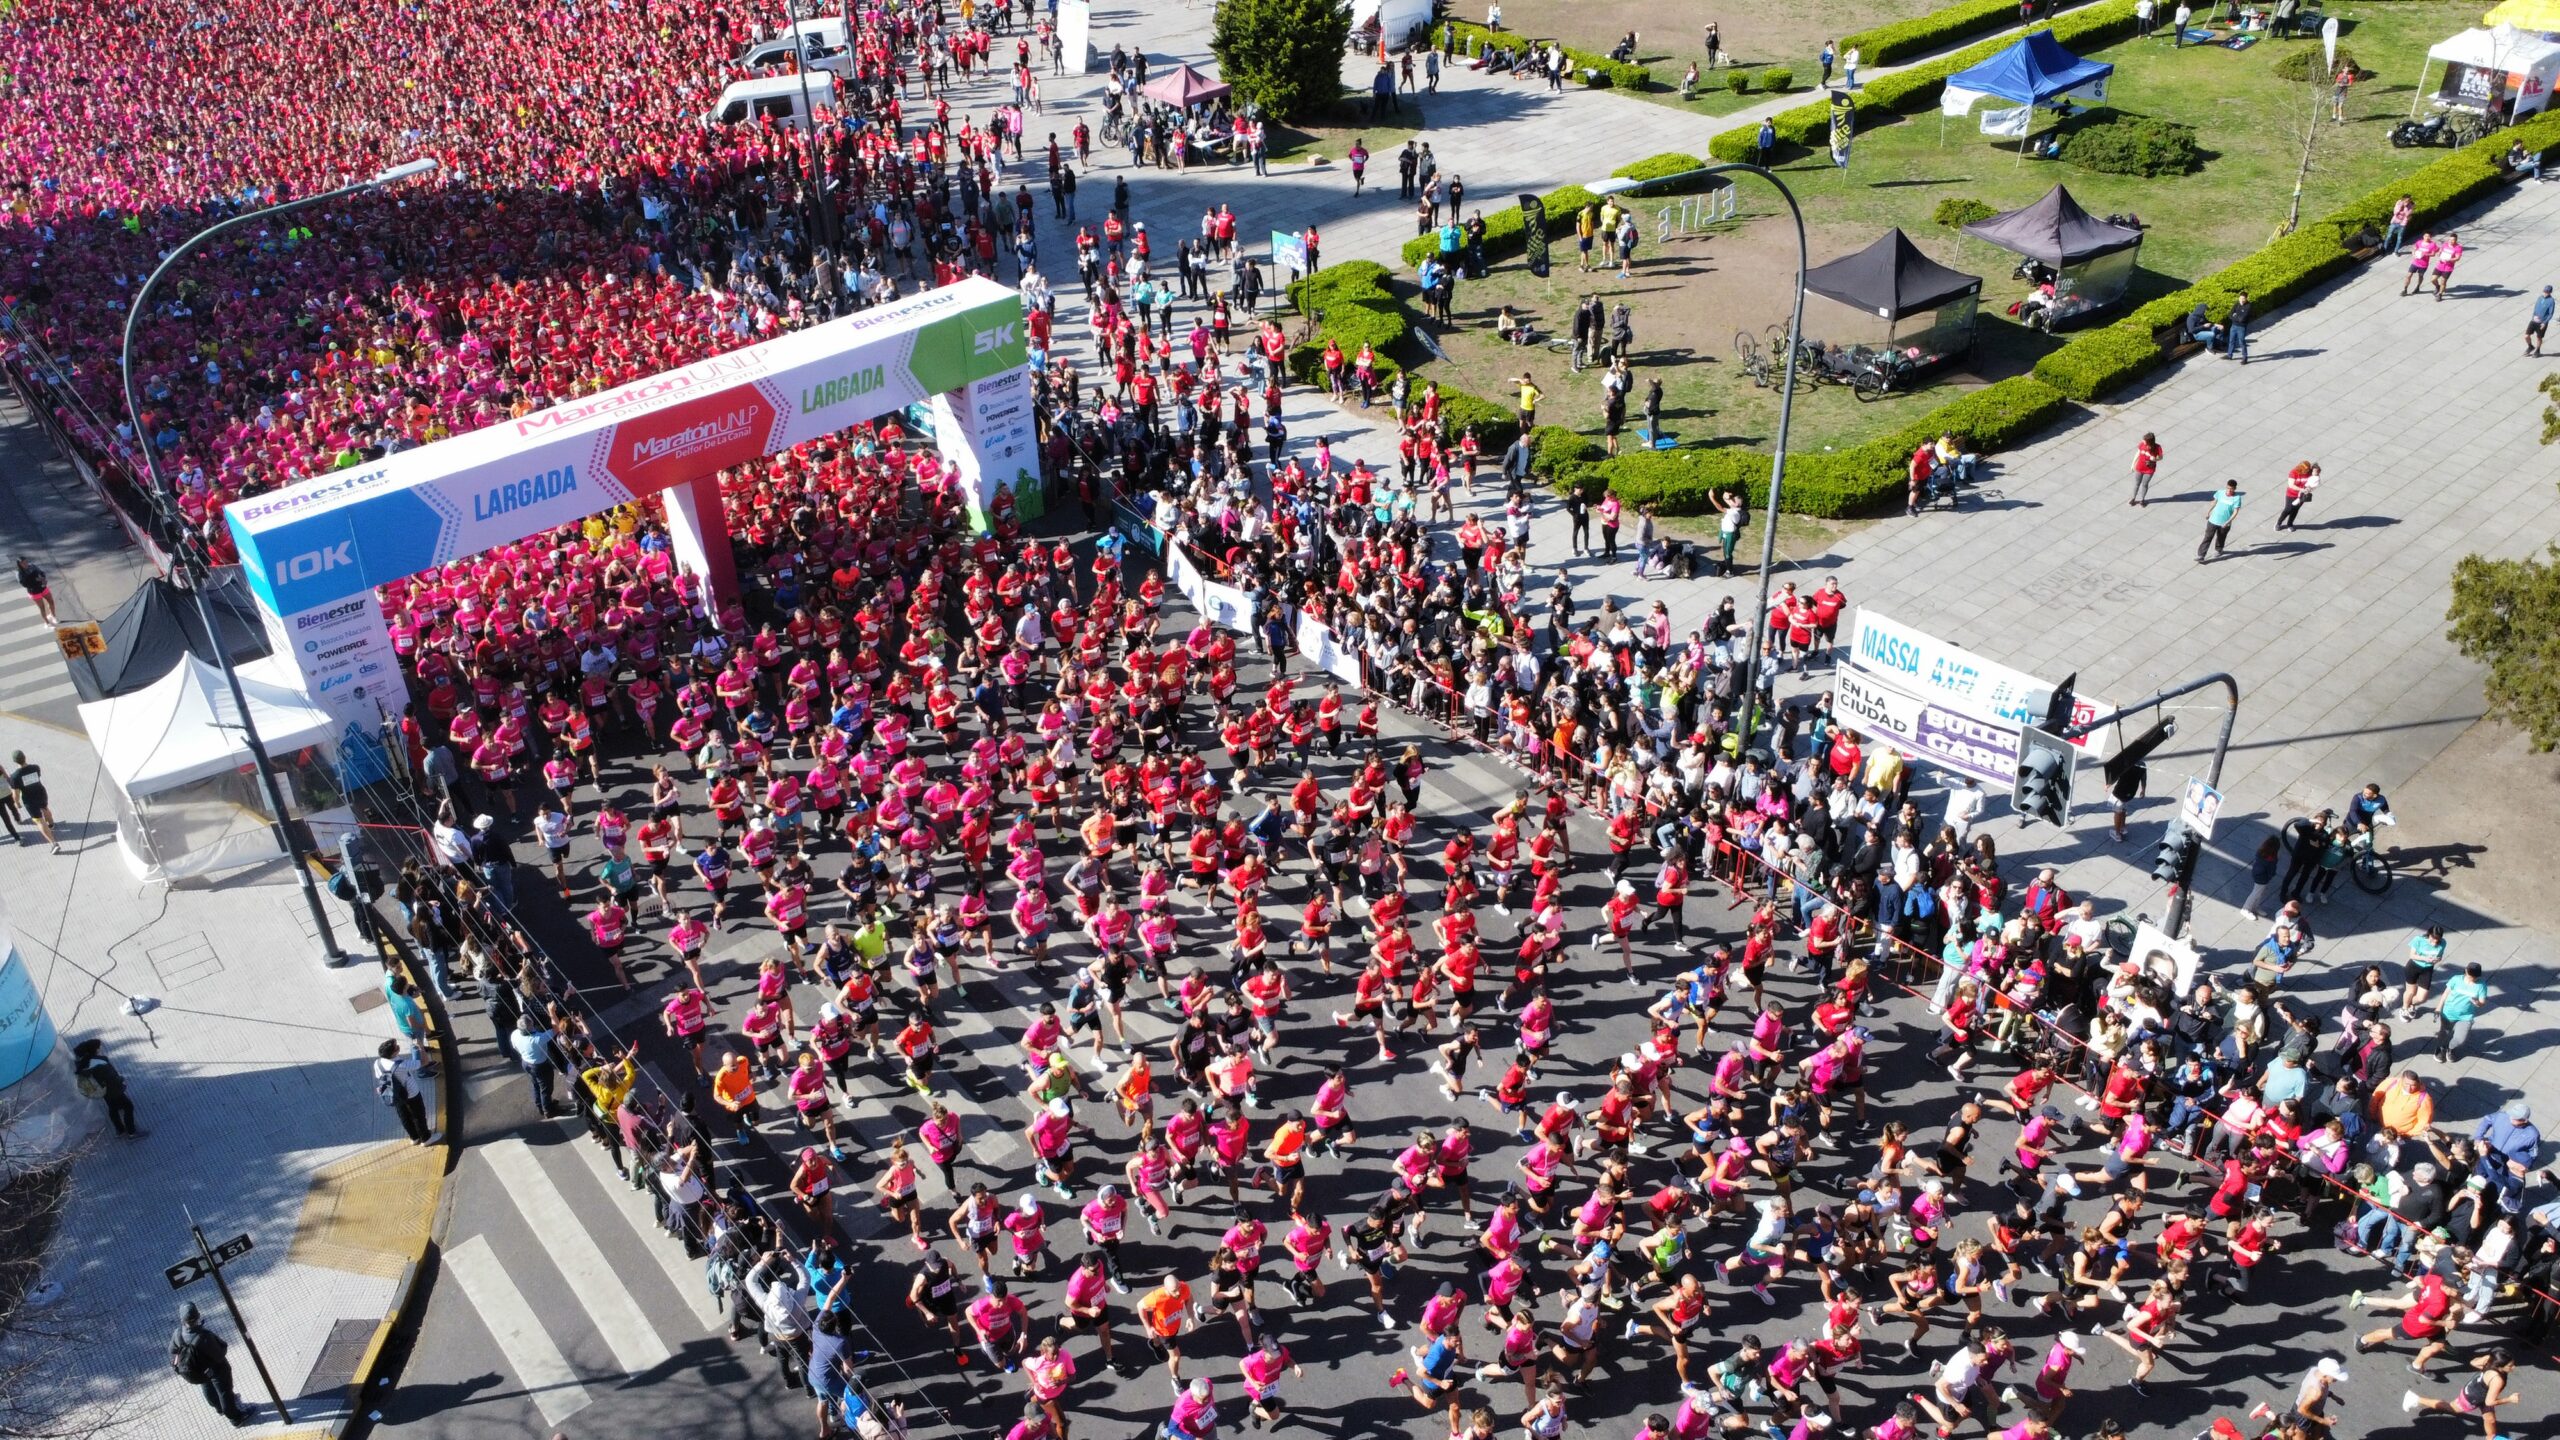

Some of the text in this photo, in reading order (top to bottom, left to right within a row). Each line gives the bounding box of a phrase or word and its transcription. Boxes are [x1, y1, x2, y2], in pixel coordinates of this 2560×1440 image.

[851, 292, 955, 330] Bienestar
[974, 321, 1015, 355] 5K
[802, 364, 885, 415] LARGADA
[675, 426, 752, 459] Delfor De La Canal
[242, 469, 388, 520] Bienestar
[474, 464, 577, 523] LARGADA
[276, 540, 353, 586] 10K
[296, 599, 366, 630] Bienestar
[317, 638, 369, 661] POWERADE
[359, 662, 379, 674] dss
[1860, 624, 1921, 677] MASSA
[1842, 677, 1886, 710] EN LA
[1839, 693, 1908, 733] CIUDAD
[1926, 731, 2018, 774] GARR
[227, 1242, 246, 1256] 51
